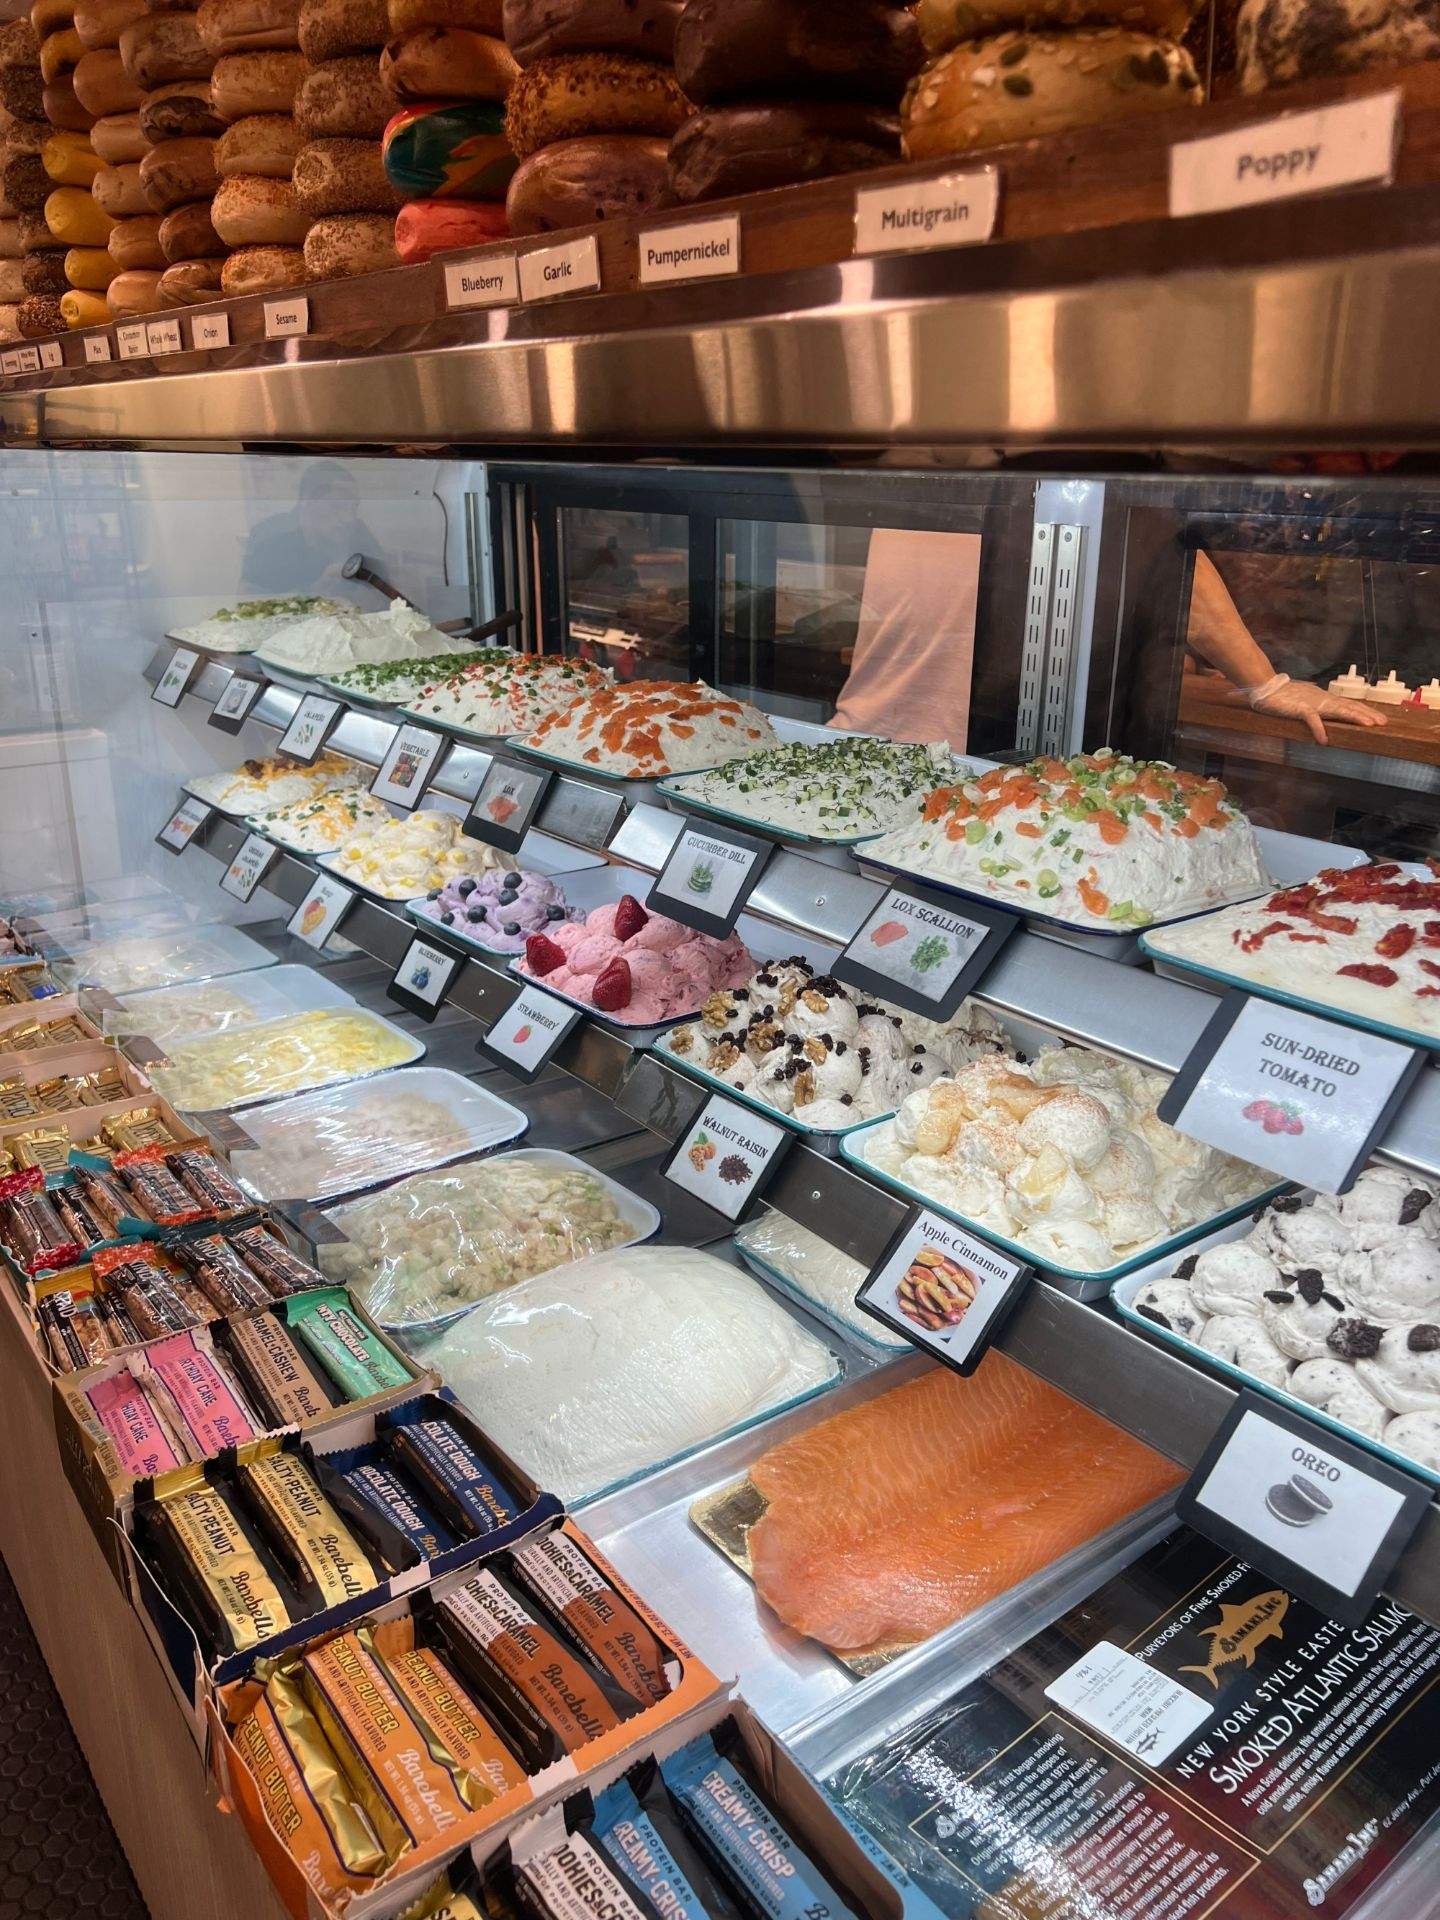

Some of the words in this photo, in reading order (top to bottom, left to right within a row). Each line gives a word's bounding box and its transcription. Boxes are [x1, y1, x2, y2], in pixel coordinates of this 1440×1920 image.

[1236, 144, 1320, 181] Poppy
[881, 201, 970, 234] Multigrain
[646, 237, 731, 268] Pumpernickel
[462, 273, 504, 293] Blueberry
[543, 261, 573, 282] Garlic
[203, 328, 218, 338] Onion
[276, 313, 297, 325] Sesame
[400, 741, 430, 757] VEGETABLE
[502, 784, 515, 795] LOX
[687, 836, 728, 858] CUCUMBER
[728, 847, 746, 865] DILL
[890, 898, 917, 917] LOX
[916, 906, 975, 940] SCALLION
[418, 947, 446, 965] BLUEBERRY
[516, 1003, 560, 1032] STRAWBERRY
[1261, 1032, 1360, 1076] SUN-DRIED
[1258, 1058, 1337, 1097] TOMATO
[702, 1115, 740, 1144] WALNUT
[739, 1134, 769, 1159] RAISIN
[917, 1220, 950, 1246] Apple
[951, 1239, 1009, 1281] Cinnamon
[329, 1321, 370, 1362] CHOCOLATE
[270, 1345, 300, 1383] CASHEW
[196, 1384, 217, 1407] CAKE
[441, 1421, 464, 1445] PROTEIN
[290, 1460, 313, 1490] PROTEIN
[310, 1488, 323, 1502] BAR
[384, 1471, 406, 1494] PROTEIN
[449, 1450, 483, 1481] DOUGH
[1291, 1447, 1342, 1483] OREO
[225, 1521, 239, 1537] BAR
[392, 1500, 425, 1531] DOUGH
[563, 1544, 592, 1576] PROTEIN
[230, 1570, 273, 1639] Barebells
[488, 1583, 518, 1611] PROTEIN
[1134, 1621, 1183, 1661] PURVEYORS
[1180, 1611, 1194, 1624] OF
[1188, 1596, 1213, 1616] FINE
[1206, 1569, 1242, 1599] SMOKED
[330, 1636, 367, 1681] PEANUT
[354, 1681, 400, 1734] BUTTER
[401, 1650, 445, 1691] PEANUT
[434, 1690, 481, 1743] BUTTER
[1176, 1741, 1215, 1779] NEW
[1212, 1701, 1260, 1742] YORK
[1255, 1659, 1303, 1701] STYLE
[1297, 1619, 1345, 1660] EASTE
[1352, 1676, 1371, 1695] cured
[328, 1663, 341, 1678] AND
[336, 1677, 368, 1720] ARTIFICIALLY
[362, 1717, 387, 1752] FLAVORED
[406, 1675, 420, 1689] AND
[415, 1689, 447, 1729] ARTIFICIALLY
[444, 1727, 471, 1760] FLAVORED
[1209, 1715, 1293, 1794] SMOKED
[1282, 1643, 1368, 1724] ATLANTIC
[1329, 1694, 1353, 1718] salmon
[1255, 1798, 1272, 1816] cold
[1267, 1777, 1293, 1804] smoked
[1290, 1767, 1305, 1782] over
[1307, 1746, 1324, 1762] oak
[1318, 1737, 1332, 1752] fire
[1334, 1724, 1347, 1737] our
[1342, 1699, 1371, 1729] signature
[1364, 1687, 1382, 1705] brick
[1378, 1678, 1392, 1692] oven
[1399, 1656, 1413, 1669] Our
[1408, 1638, 1430, 1660] Eastern
[1281, 1788, 1306, 1814] subtle,
[1299, 1771, 1322, 1795] smoky
[1316, 1753, 1339, 1777] flavour
[1334, 1743, 1349, 1758] and
[1344, 1723, 1368, 1747] smooth
[1362, 1706, 1386, 1730] velvety
[1397, 1672, 1418, 1693] Perfect
[1298, 1733, 1314, 1748] this
[1309, 1712, 1334, 1738] smoked
[266, 1722, 290, 1771] PROTEIN
[998, 1771, 1015, 1788] first
[1012, 1754, 1036, 1777] began
[1032, 1730, 1064, 1760] smoking
[1276, 1743, 1305, 1771] delicacy,
[1023, 1769, 1038, 1784] the
[1035, 1751, 1060, 1775] slopes
[1047, 1777, 1074, 1802] supply
[1068, 1755, 1098, 1784] Kenya's
[1071, 1770, 1103, 1801] (Samaki
[1259, 1765, 1281, 1787] Scotia
[264, 1766, 302, 1836] BUTTER
[1025, 1787, 1040, 1802] the
[1036, 1775, 1054, 1792] late
[1240, 1795, 1251, 1806] A
[1245, 1781, 1265, 1801] Nova
[702, 1771, 756, 1827] CREAMY
[749, 1827, 796, 1878] CRISP
[710, 1808, 725, 1824] AND
[733, 1779, 769, 1824] PROTEIN
[769, 1825, 790, 1849] BAR
[1051, 1818, 1071, 1838] word
[1067, 1809, 1080, 1823] for
[1071, 1812, 1097, 1837] earned
[1099, 1778, 1136, 1813] reputation
[1096, 1808, 1125, 1836] smoked
[1121, 1797, 1137, 1813] fish
[1095, 1828, 1126, 1859] gourmet
[1122, 1811, 1146, 1835] shops
[1095, 1863, 1110, 1878] the
[1107, 1838, 1140, 1869] company
[1136, 1817, 1161, 1841] moved
[1122, 1852, 1147, 1876] where
[1157, 1829, 1173, 1845] now
[583, 1851, 621, 1897] PROTEIN
[640, 1824, 674, 1874] PROTEIN
[672, 1878, 692, 1902] BAR
[1113, 1887, 1131, 1906] Port
[1129, 1867, 1155, 1893] Jervis,
[1150, 1854, 1169, 1872] New
[1174, 1869, 1200, 1895] known
[1196, 1860, 1210, 1874] for
[1131, 1882, 1162, 1912] remains
[1159, 1875, 1171, 1887] an
[1181, 1892, 1198, 1909] fish
[1195, 1865, 1230, 1898] products.
